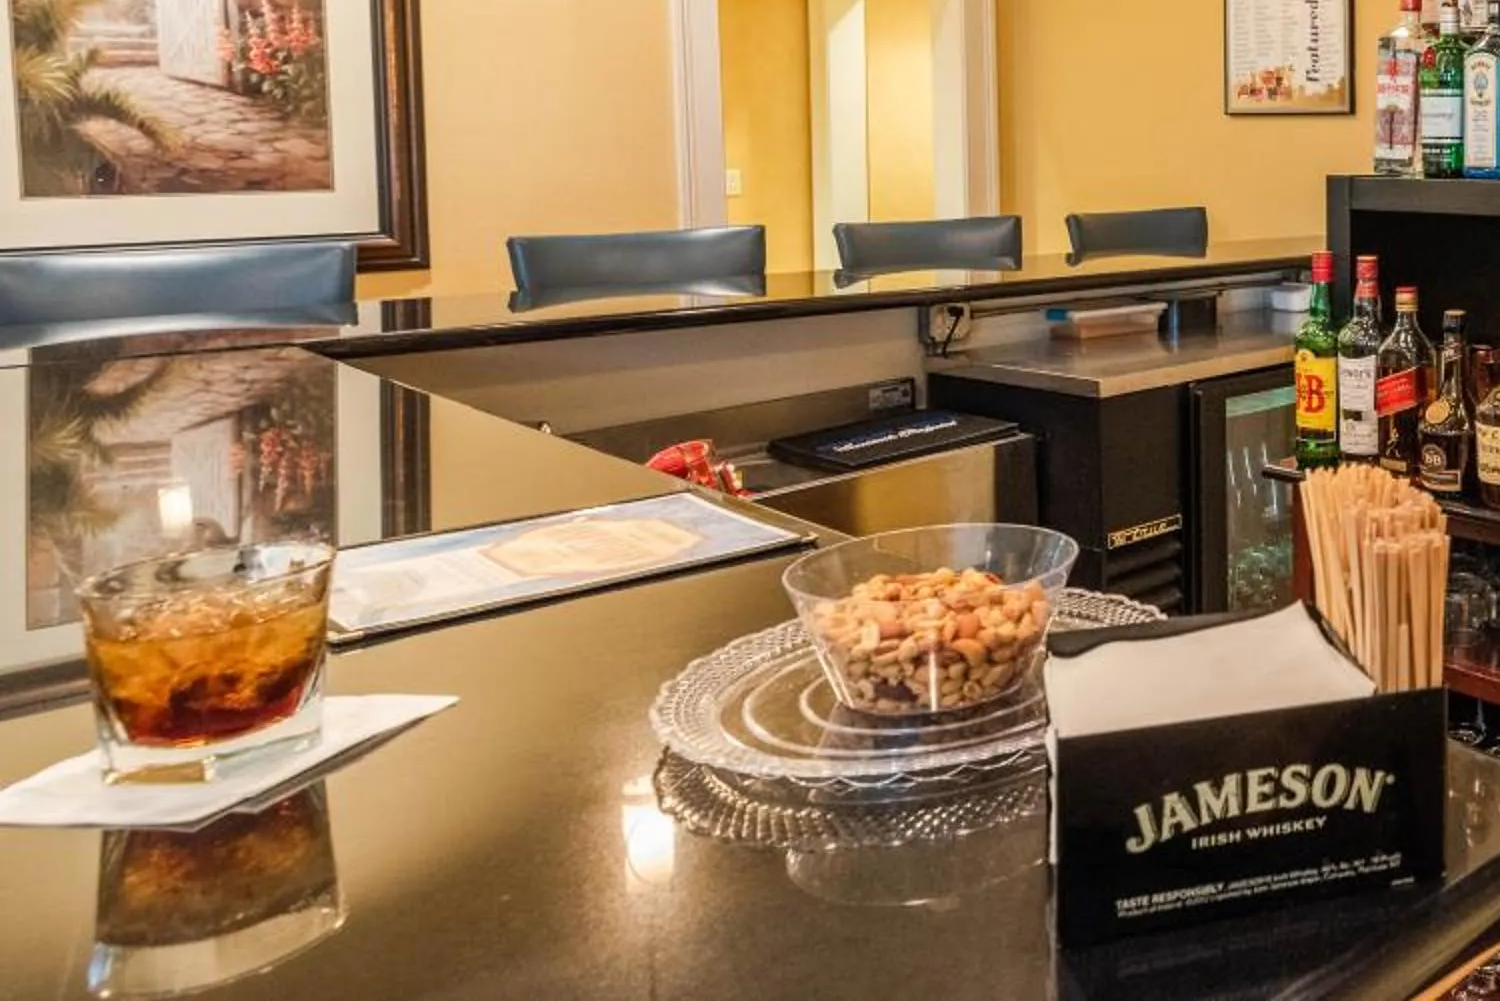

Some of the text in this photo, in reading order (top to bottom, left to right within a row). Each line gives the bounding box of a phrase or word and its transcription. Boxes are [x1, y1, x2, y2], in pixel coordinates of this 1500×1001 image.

[1125, 763, 1387, 855] JAMESON
[1190, 814, 1329, 850] IRISH WHISKEY
[1115, 894, 1150, 910] TASTE
